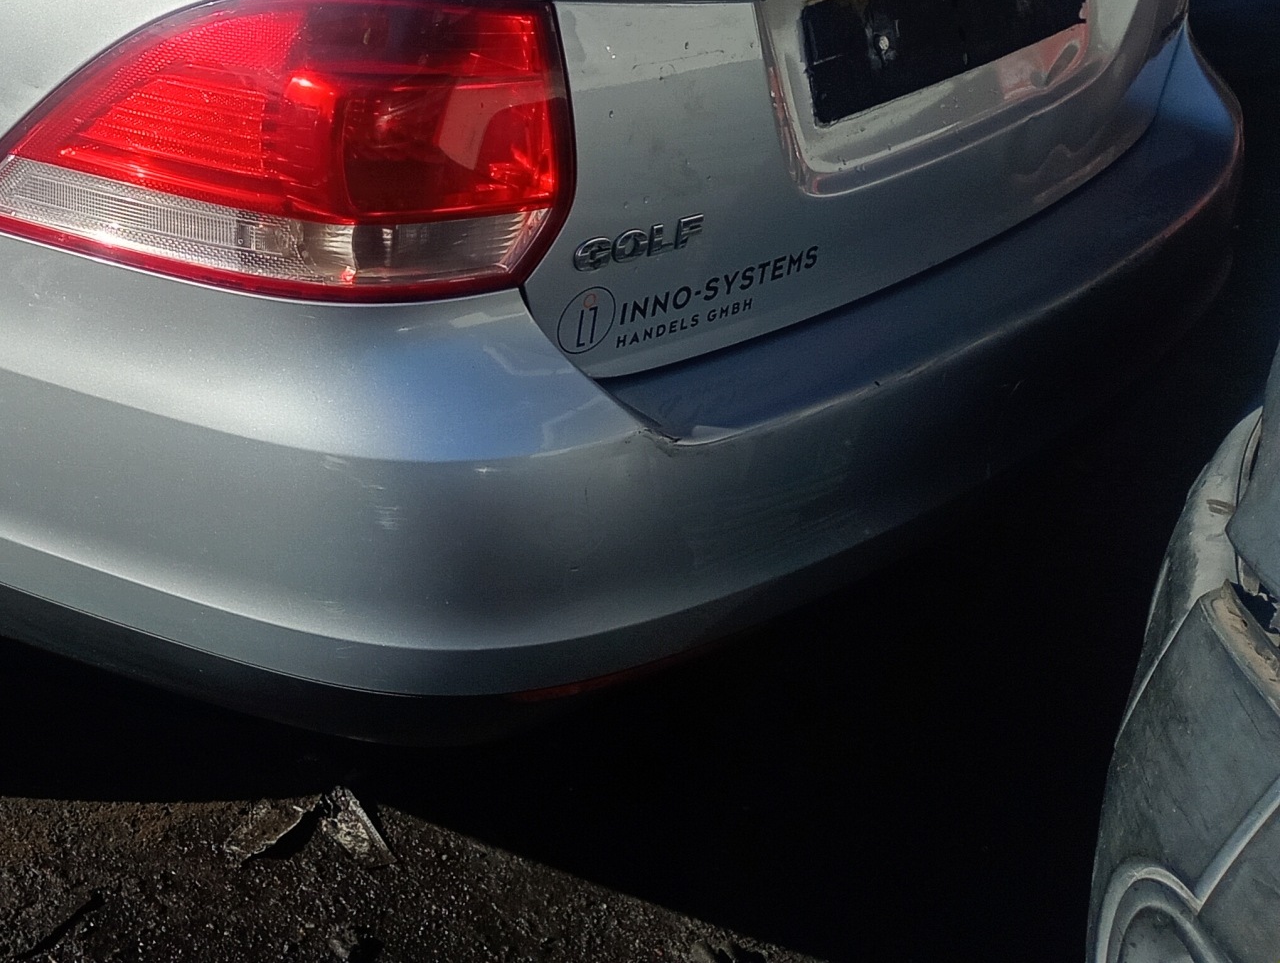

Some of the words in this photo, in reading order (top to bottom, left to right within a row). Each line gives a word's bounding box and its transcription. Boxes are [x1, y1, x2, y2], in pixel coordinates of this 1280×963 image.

[573, 213, 705, 272] GOLF
[619, 245, 819, 325] INNO-SYSTEMS
[616, 314, 700, 349] HANDELS
[706, 297, 754, 323] GMBH
